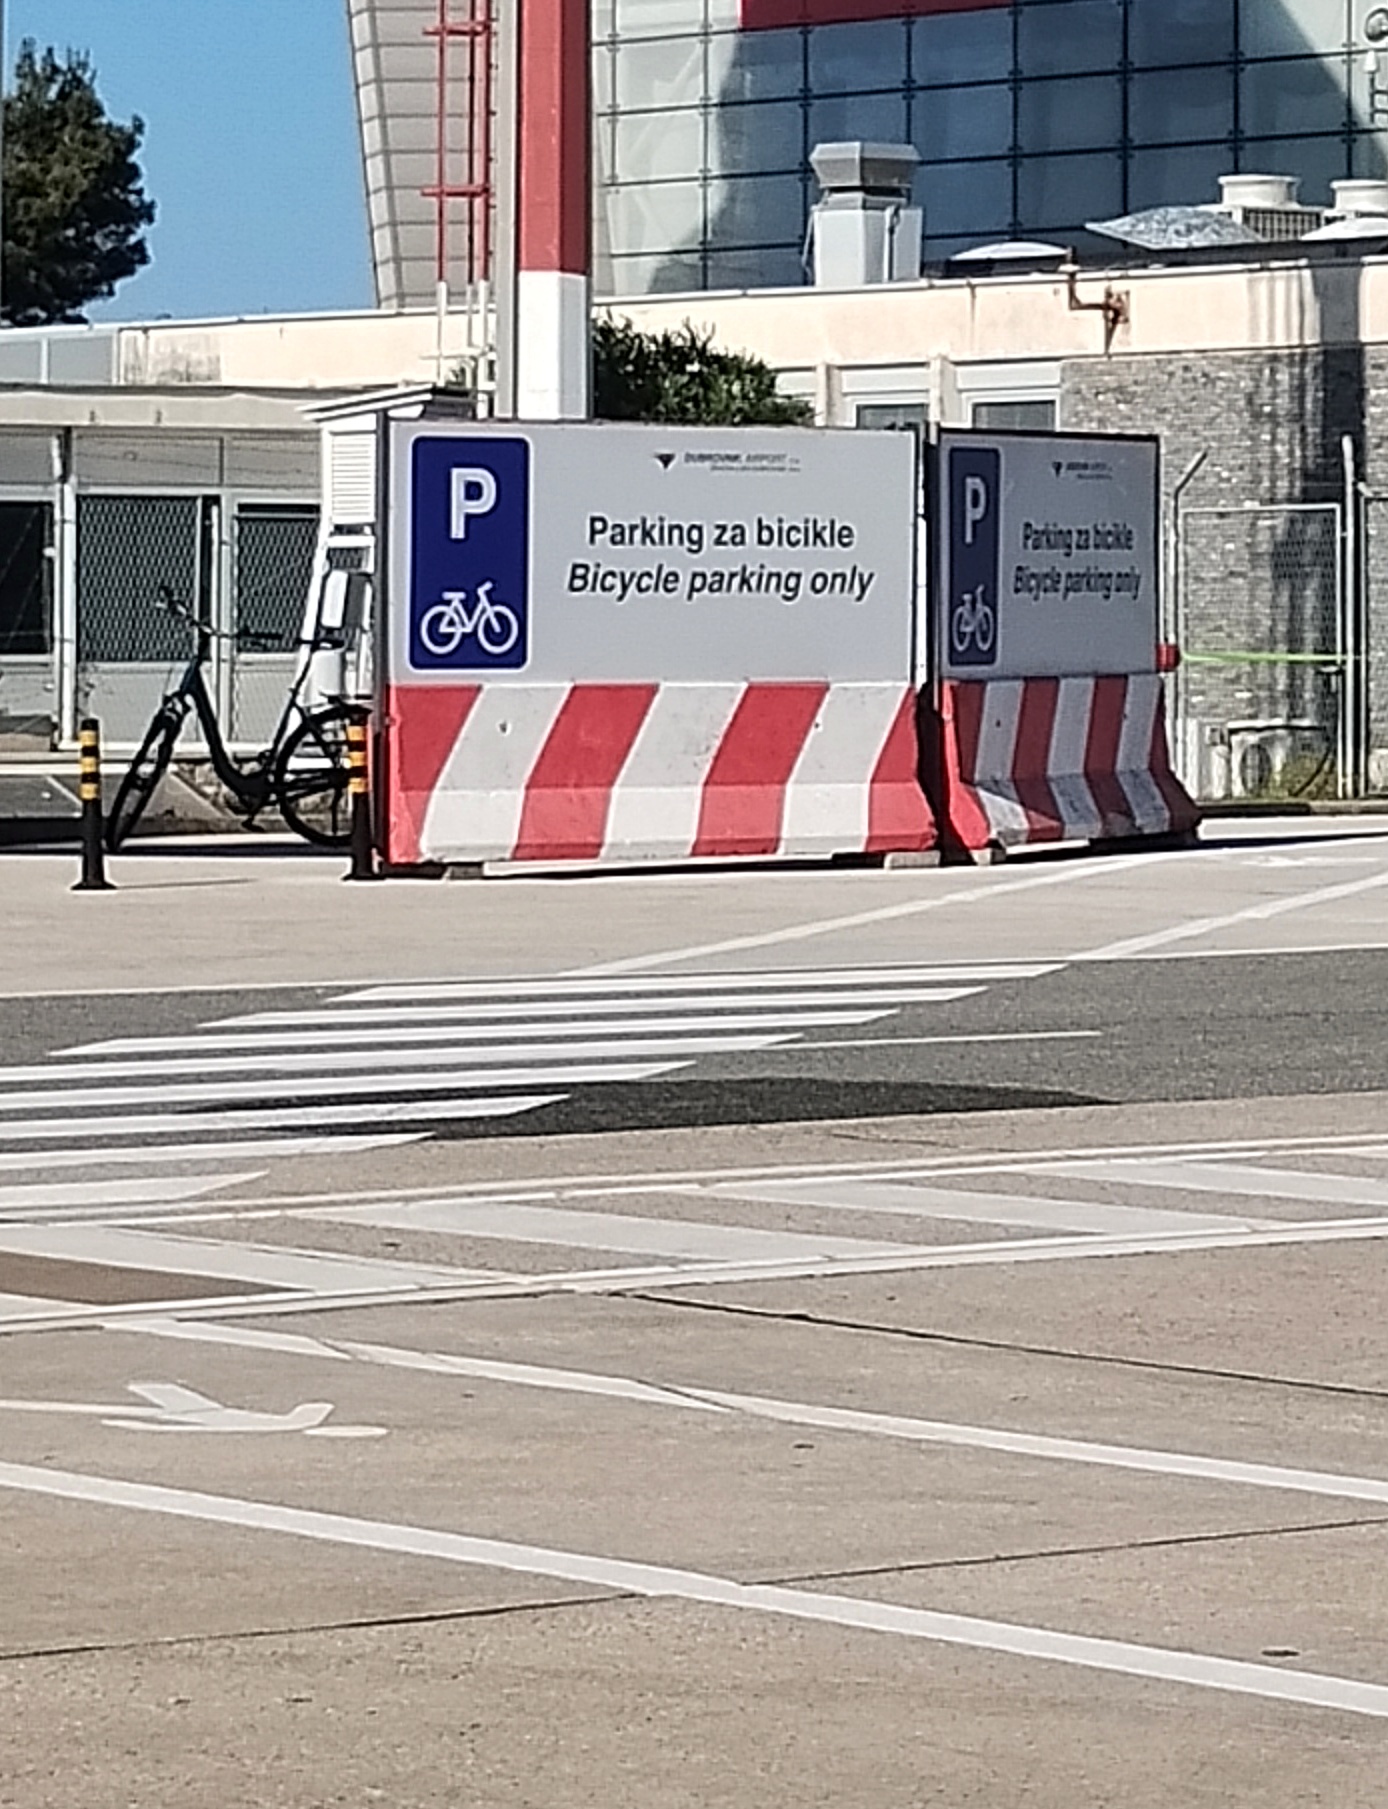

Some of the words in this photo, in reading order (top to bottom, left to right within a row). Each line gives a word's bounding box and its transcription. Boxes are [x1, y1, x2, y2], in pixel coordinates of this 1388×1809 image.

[449, 466, 498, 540] P
[965, 476, 987, 545] P
[588, 515, 704, 555] Parking
[713, 523, 747, 547] za
[756, 516, 855, 549] bicikle
[1022, 522, 1072, 557] Parking
[1076, 529, 1090, 550] za
[567, 563, 681, 603] Bicycle
[686, 563, 802, 602] parking
[809, 564, 875, 603] only
[1013, 565, 1062, 601] Bicycle
[1062, 566, 1113, 600] parking
[1114, 566, 1141, 601] only
